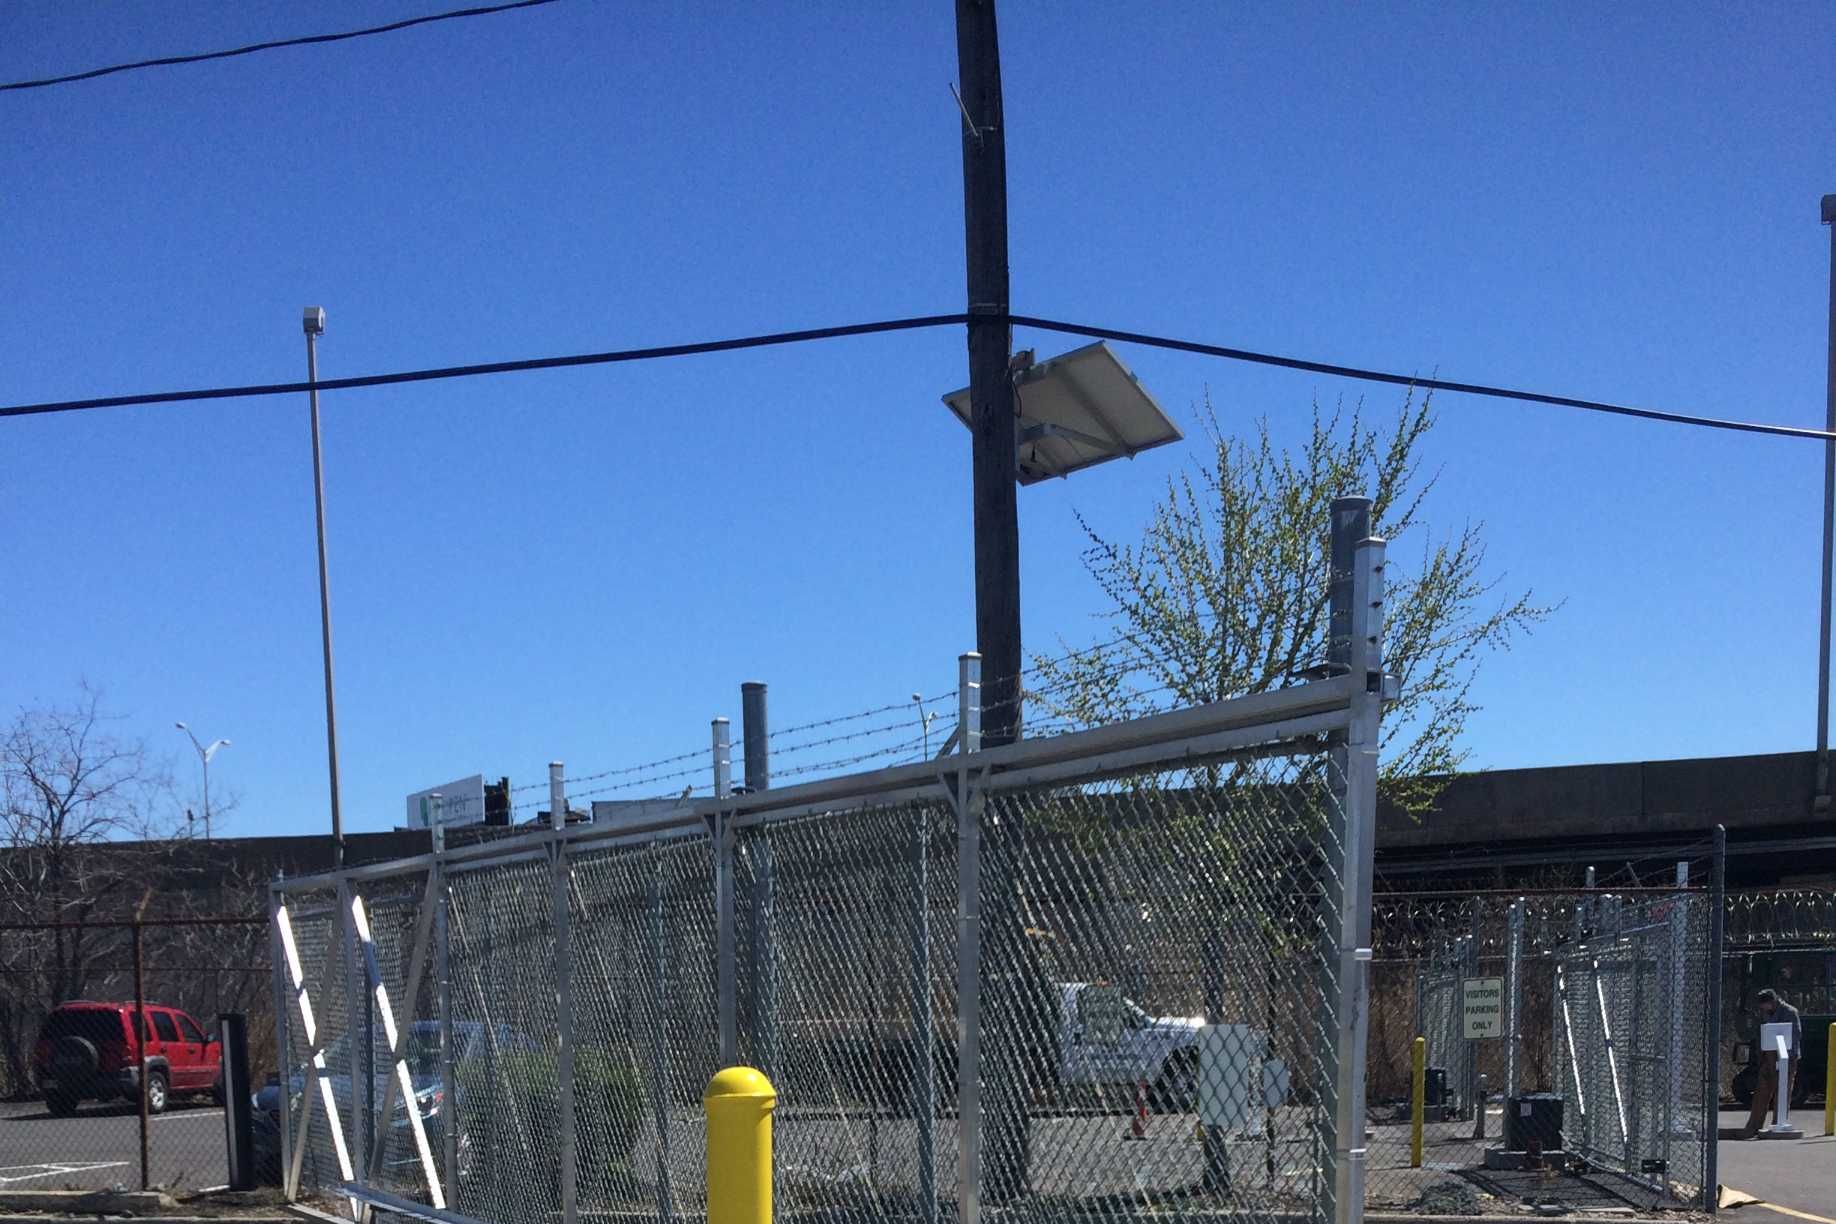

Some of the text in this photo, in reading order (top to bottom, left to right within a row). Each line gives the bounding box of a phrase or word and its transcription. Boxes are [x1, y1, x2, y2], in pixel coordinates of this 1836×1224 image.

[1465, 989, 1499, 999] VISITORS
[1465, 1005, 1499, 1015] PARKING
[1472, 1021, 1493, 1030] ONLY
